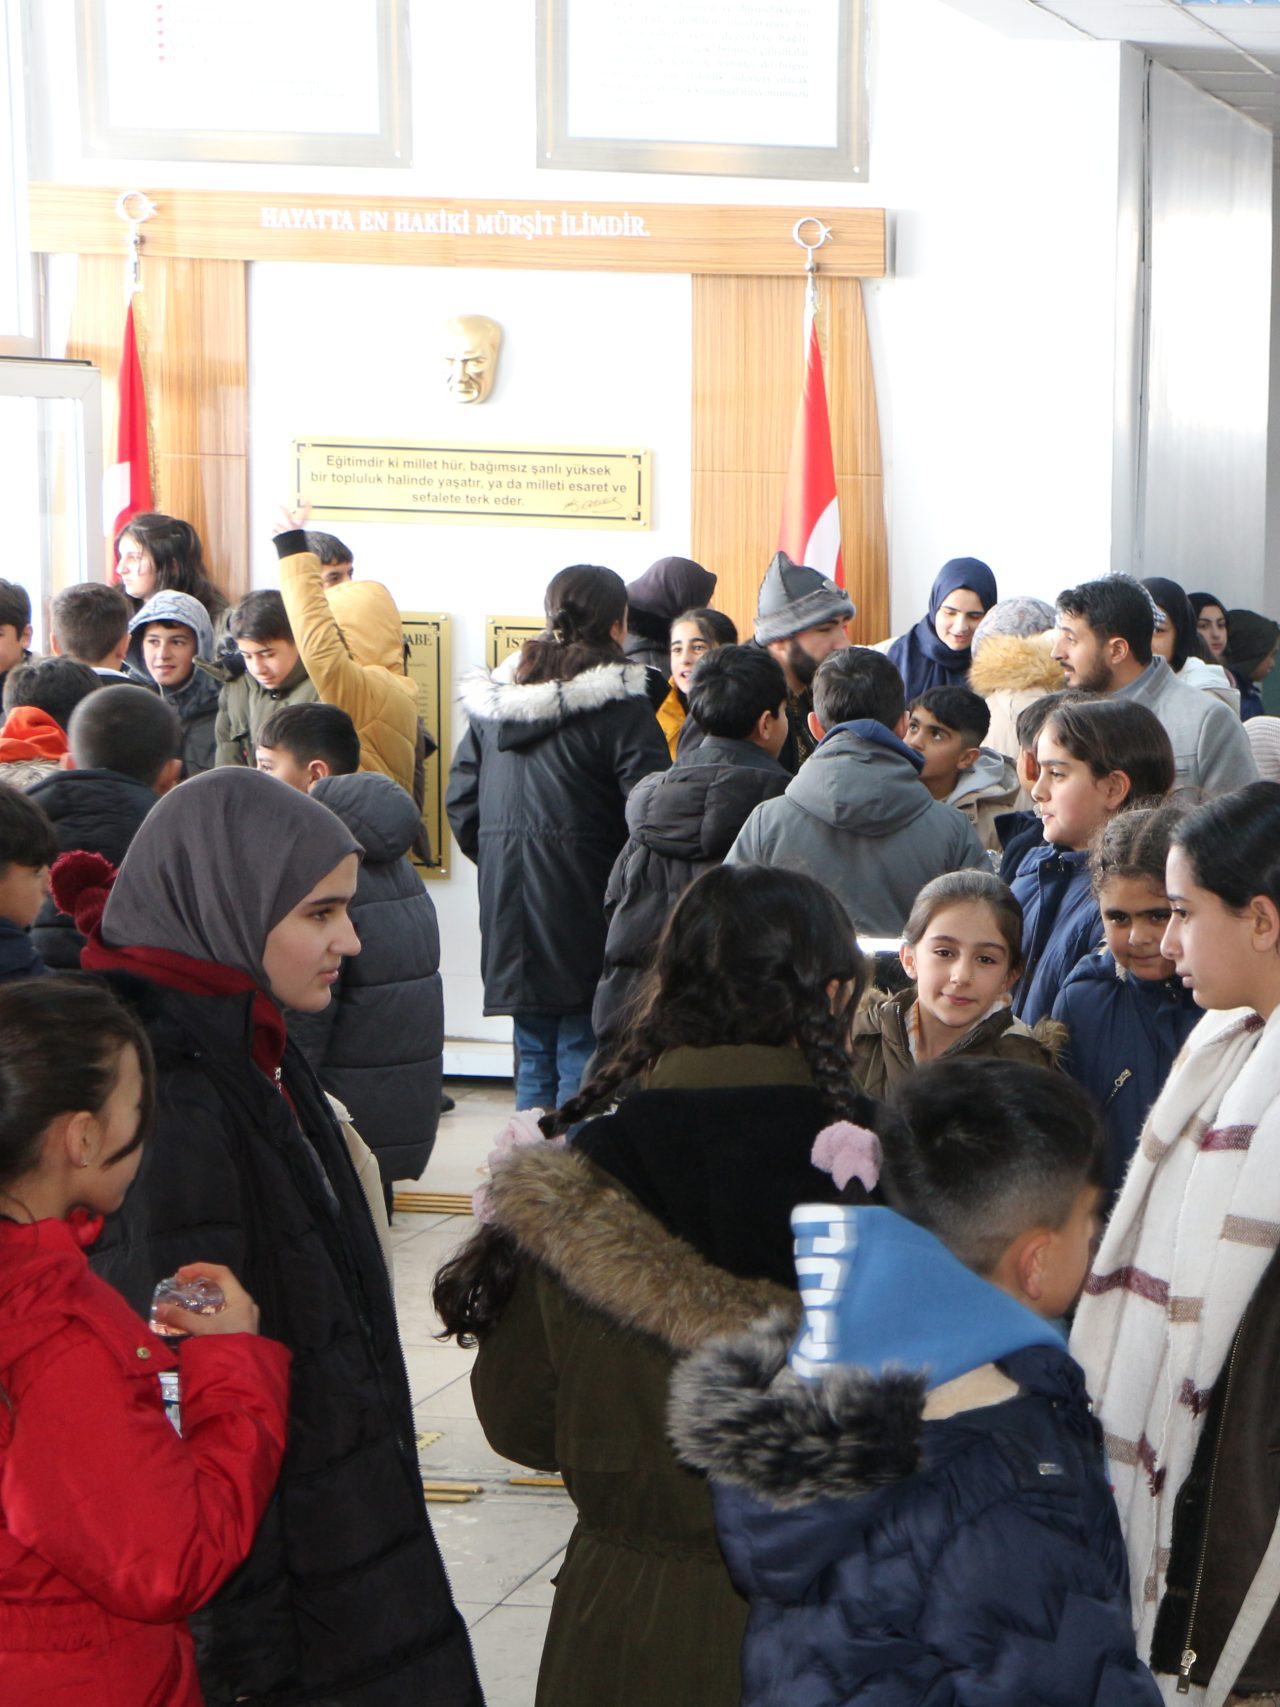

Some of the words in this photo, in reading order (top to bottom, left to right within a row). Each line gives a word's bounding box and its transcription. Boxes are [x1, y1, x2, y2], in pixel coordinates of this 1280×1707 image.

[260, 206, 355, 231] HAYATTA
[359, 210, 388, 232] EN
[394, 208, 470, 235] HAKİKİ
[476, 209, 557, 240] MÜRŞİT
[561, 210, 651, 238] İLİMDİR.
[326, 455, 384, 469] Eğitimdir
[388, 457, 399, 468] ki
[403, 457, 438, 470] millet
[470, 460, 528, 474] bağımsız
[531, 463, 562, 475] şanlı
[566, 464, 611, 478] yüksek
[311, 472, 327, 483] bir
[331, 472, 383, 485] topluluk
[387, 474, 434, 487] halinde
[487, 480, 503, 491] ya
[506, 478, 522, 490] da
[526, 480, 565, 492] milleti
[568, 481, 608, 493] esaret
[612, 483, 627, 494] ve
[412, 491, 461, 504] sefalete
[465, 494, 490, 505] terk
[494, 494, 525, 506] eder.
